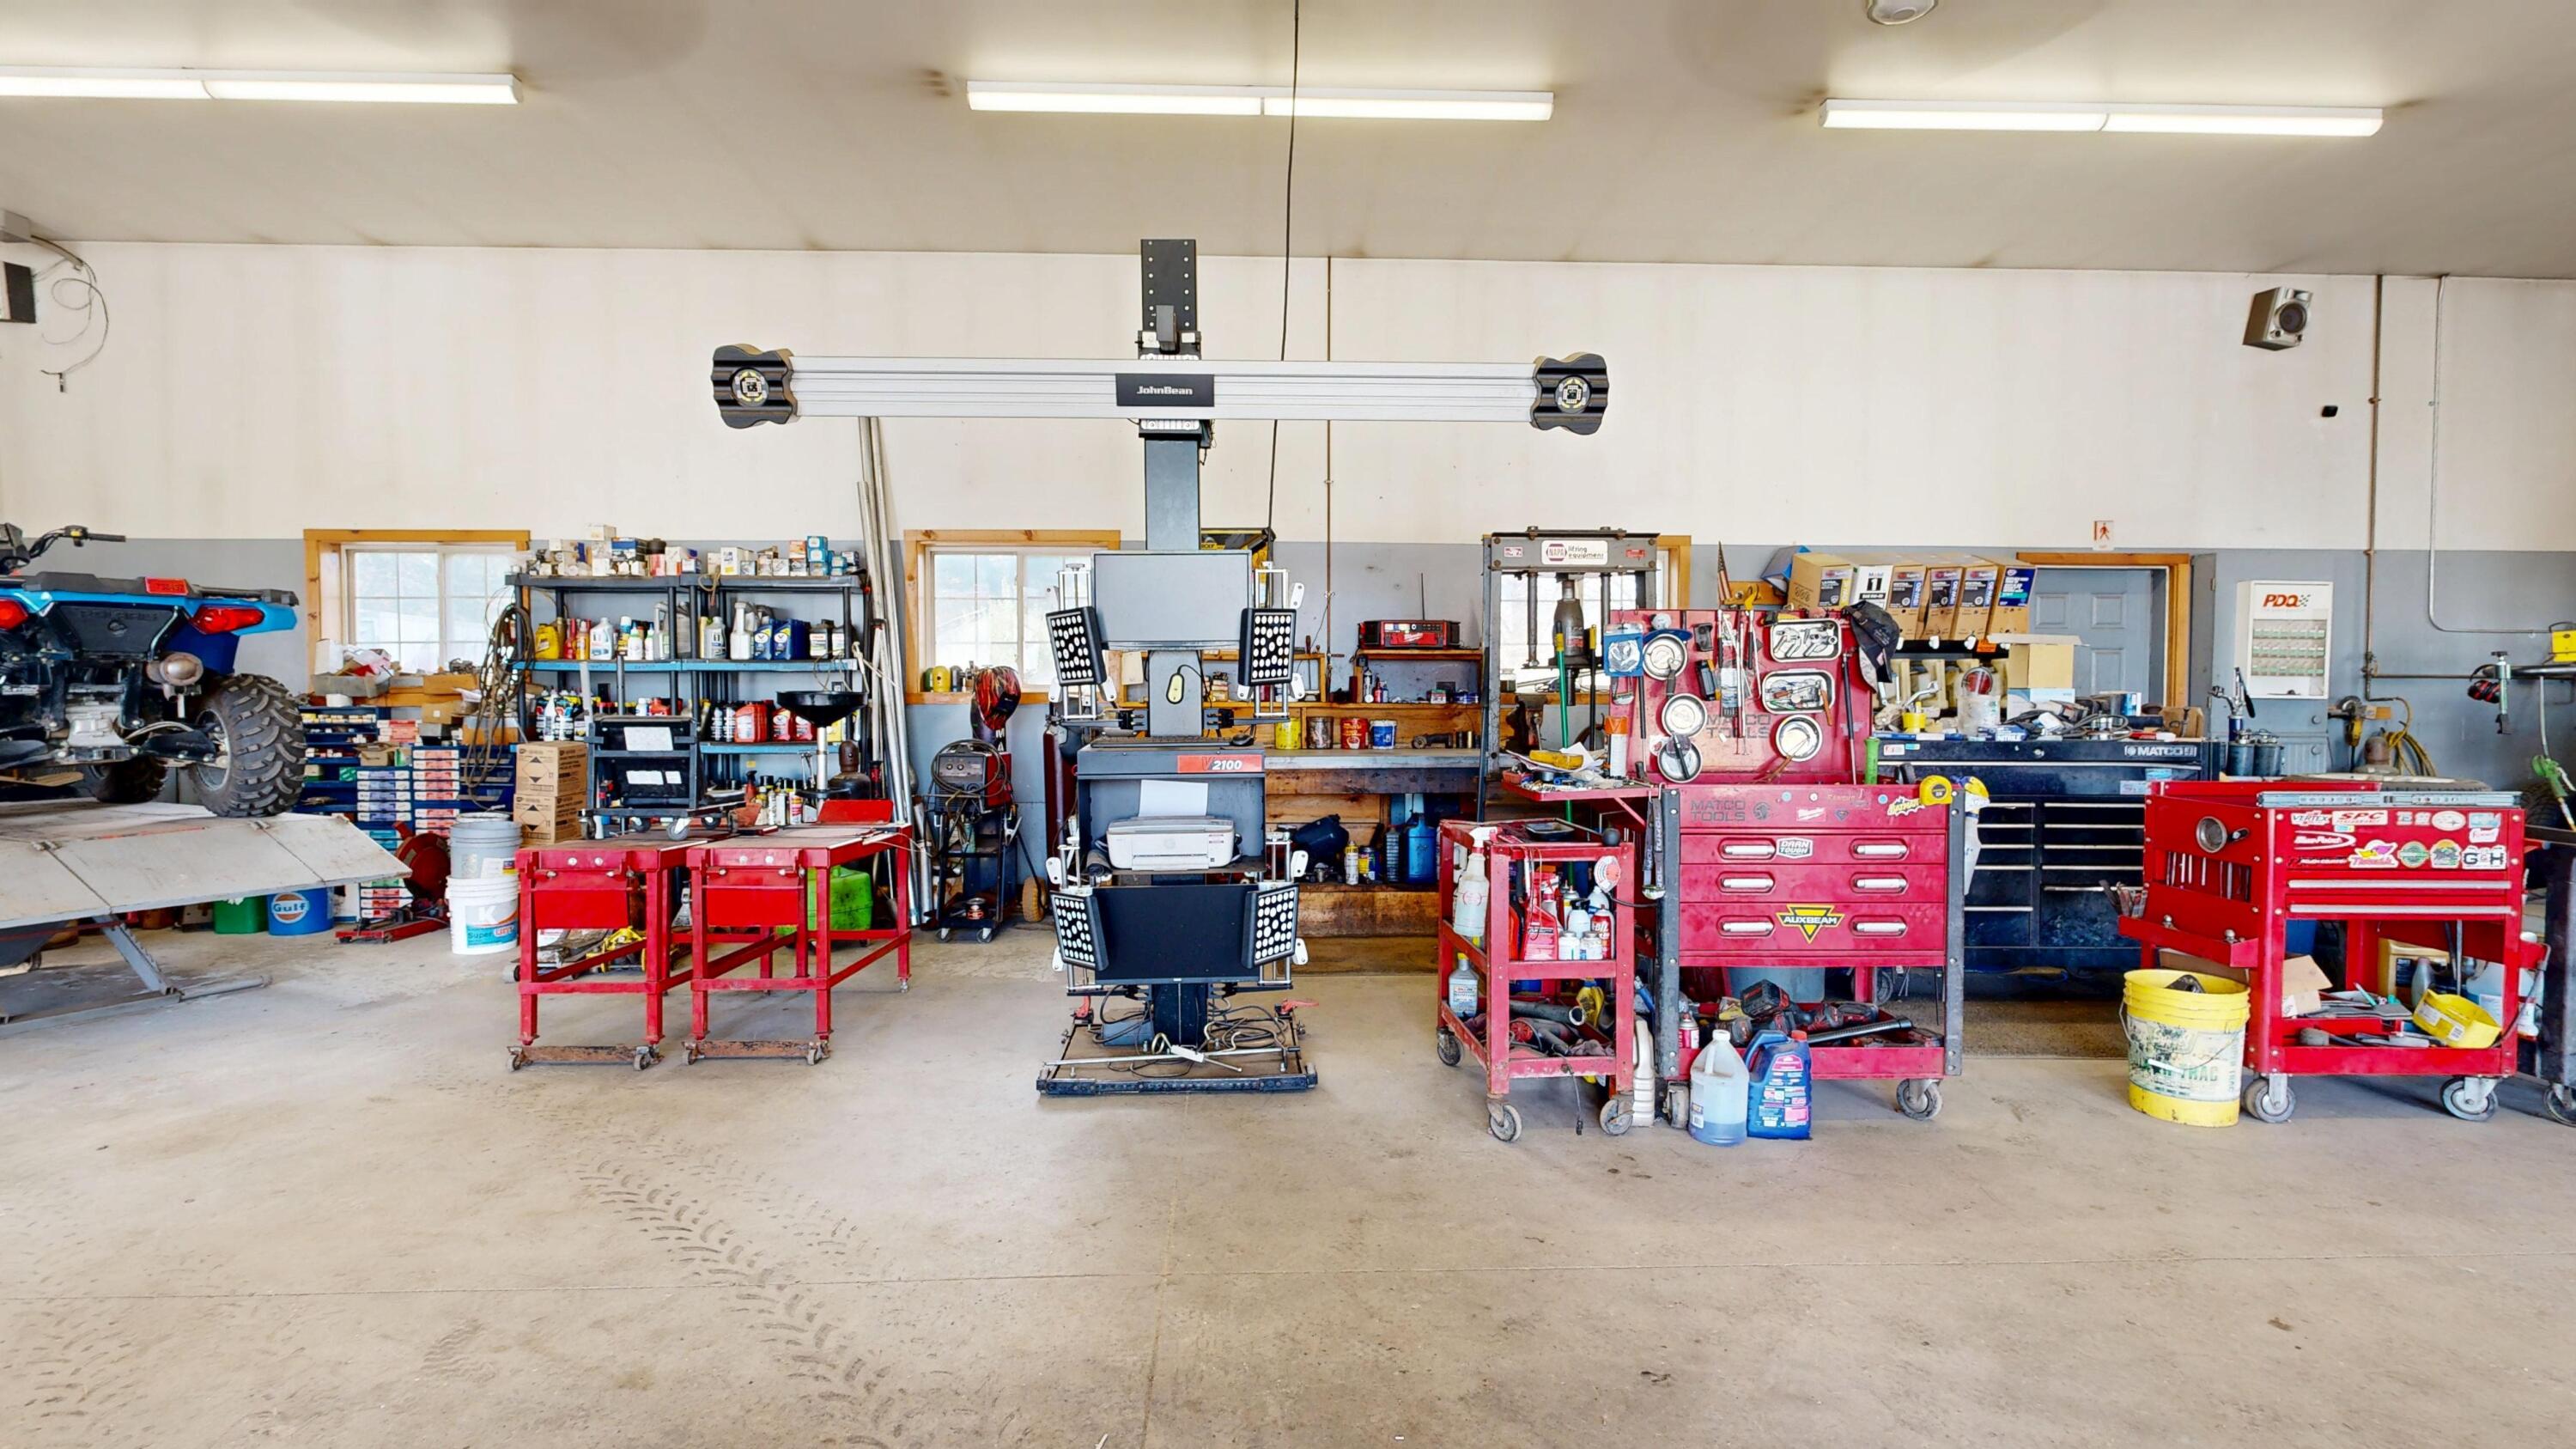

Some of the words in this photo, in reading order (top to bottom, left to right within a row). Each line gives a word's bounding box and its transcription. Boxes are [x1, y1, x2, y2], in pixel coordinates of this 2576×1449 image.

[1136, 386, 1194, 395] JohnBean
[2263, 594, 2300, 607] PDQ
[1706, 714, 1771, 725] MACO
[1706, 727, 1769, 738] TOLS
[2137, 746, 2183, 756] MATCO
[1691, 801, 1745, 811] MATCO
[1691, 812, 1745, 821] TOOLS
[2489, 853, 2504, 865] H
[273, 903, 306, 912] Gulf
[478, 906, 496, 923] K
[1783, 916, 1838, 924] AUXBEAM
[2181, 1065, 2218, 1081] RAC
